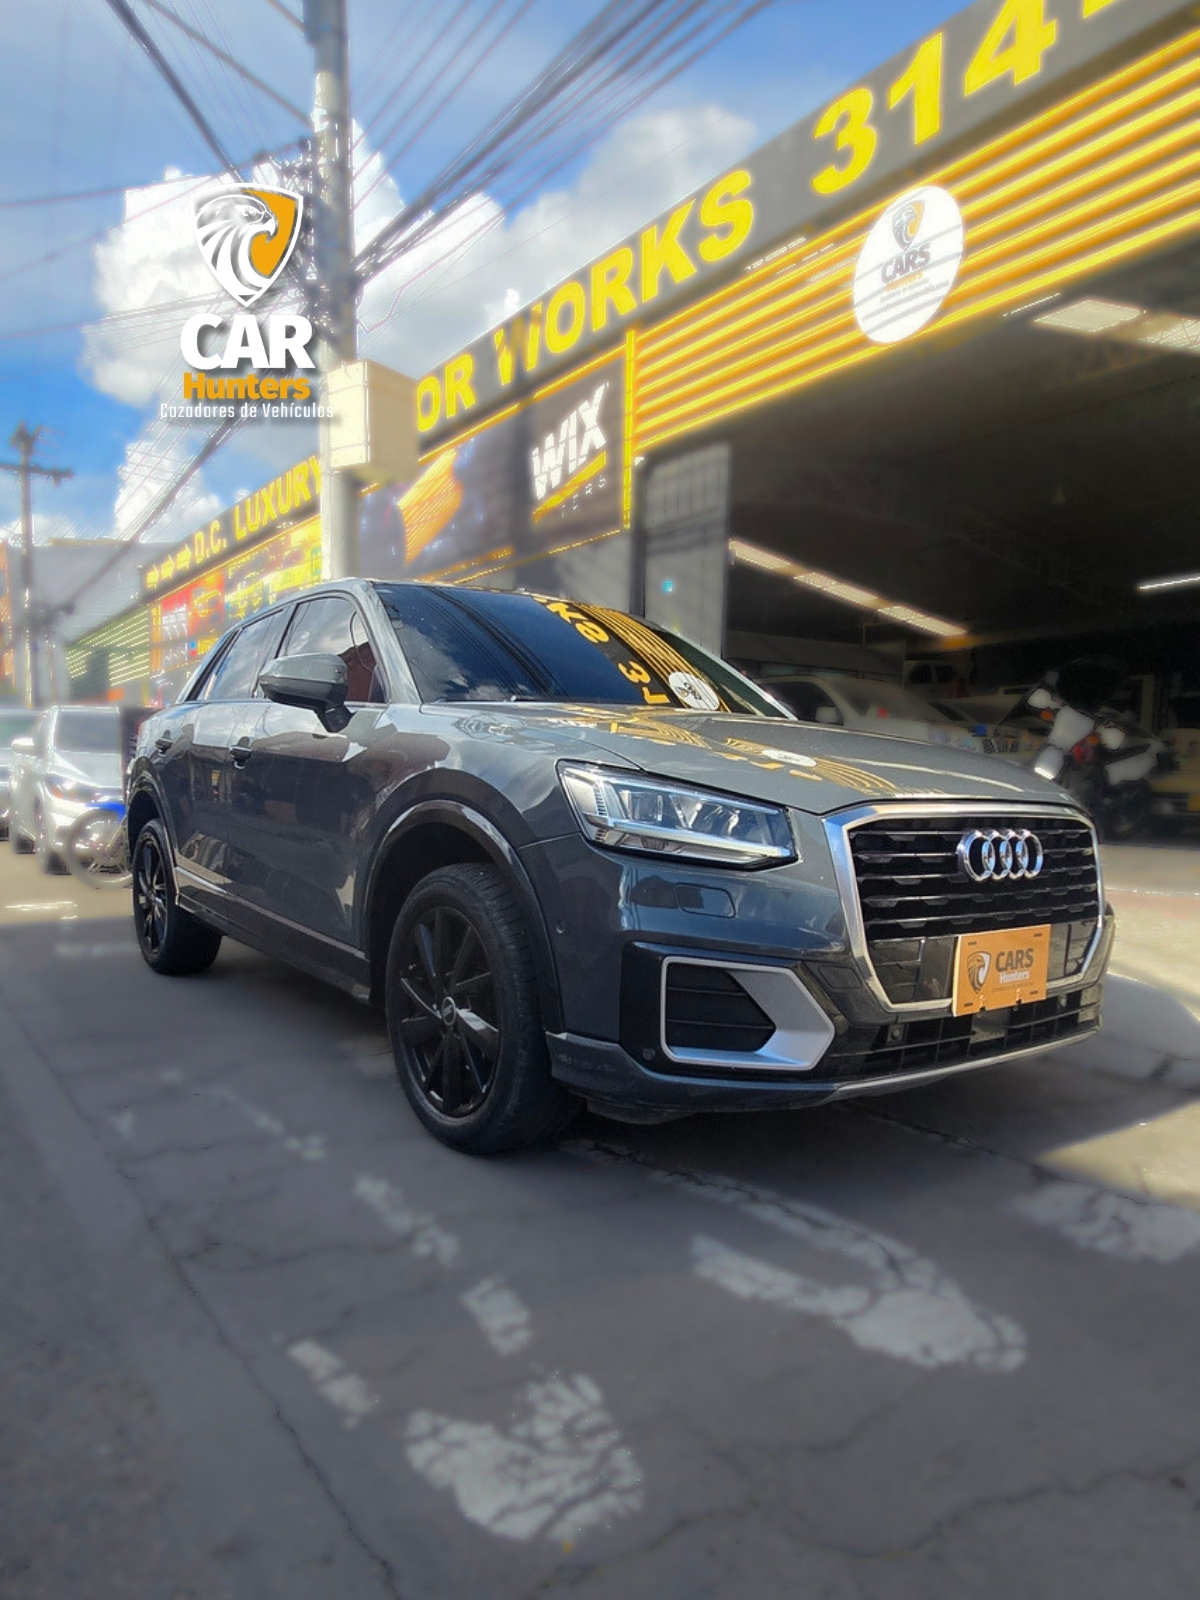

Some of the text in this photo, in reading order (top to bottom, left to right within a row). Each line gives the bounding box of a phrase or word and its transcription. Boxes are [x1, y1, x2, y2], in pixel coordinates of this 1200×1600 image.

[495, 170, 753, 386] WORKS
[811, 0, 1120, 195] 314
[881, 241, 932, 284] CARS
[531, 382, 607, 500] WIX
[995, 947, 1034, 973] CARS
